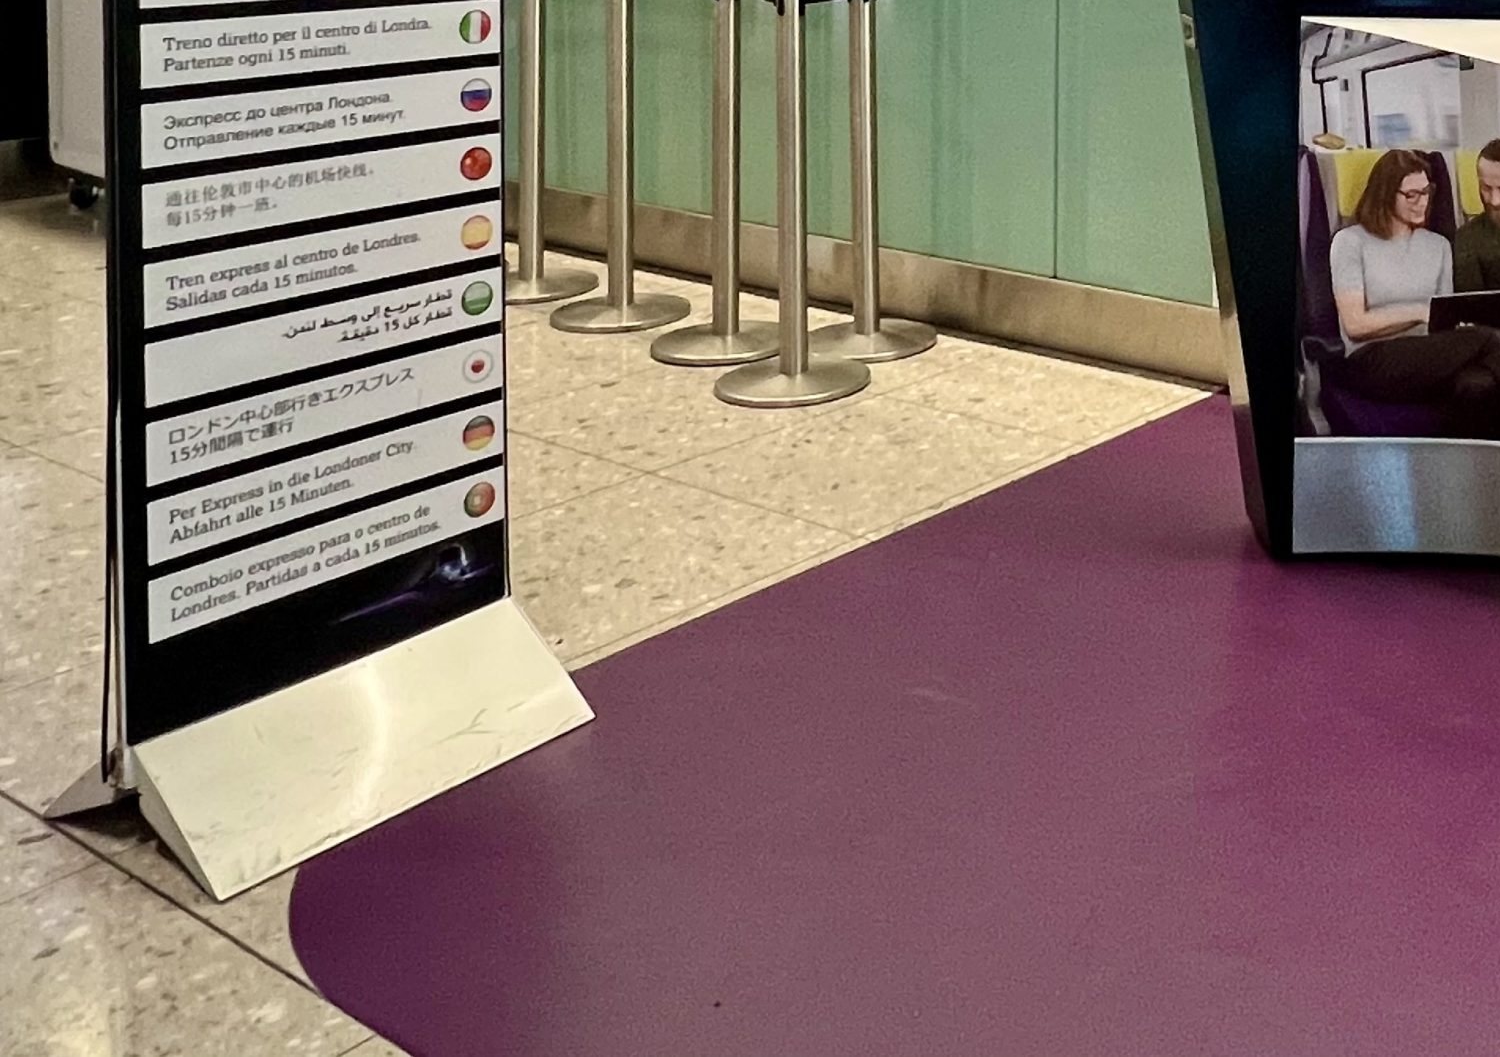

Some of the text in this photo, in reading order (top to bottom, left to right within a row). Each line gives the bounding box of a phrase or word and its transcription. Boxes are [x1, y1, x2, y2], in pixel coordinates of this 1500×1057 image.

[163, 36, 212, 51] Treno
[217, 31, 268, 47] diretto
[273, 31, 297, 44] per
[302, 27, 310, 39] il
[316, 24, 360, 39] centro
[364, 21, 376, 34] di
[163, 55, 234, 72] Partenze
[239, 50, 272, 67] ogni
[278, 48, 295, 61] 15
[166, 275, 205, 289] Tren
[210, 261, 270, 284] express
[274, 254, 287, 269] al
[292, 248, 338, 265] centro
[342, 243, 359, 256] de
[166, 289, 227, 311] Salidas
[232, 279, 269, 297] cada
[274, 273, 291, 288] 15
[170, 508, 196, 524] Per
[202, 486, 263, 515] Express
[269, 480, 282, 494] in
[287, 470, 310, 488] die
[315, 451, 381, 479] Londoner
[171, 504, 430, 601] Comboio expresso para o centro de
[246, 565, 308, 595] Partidas
[312, 560, 321, 572] a
[325, 547, 360, 569] cada
[365, 539, 380, 556] 15
